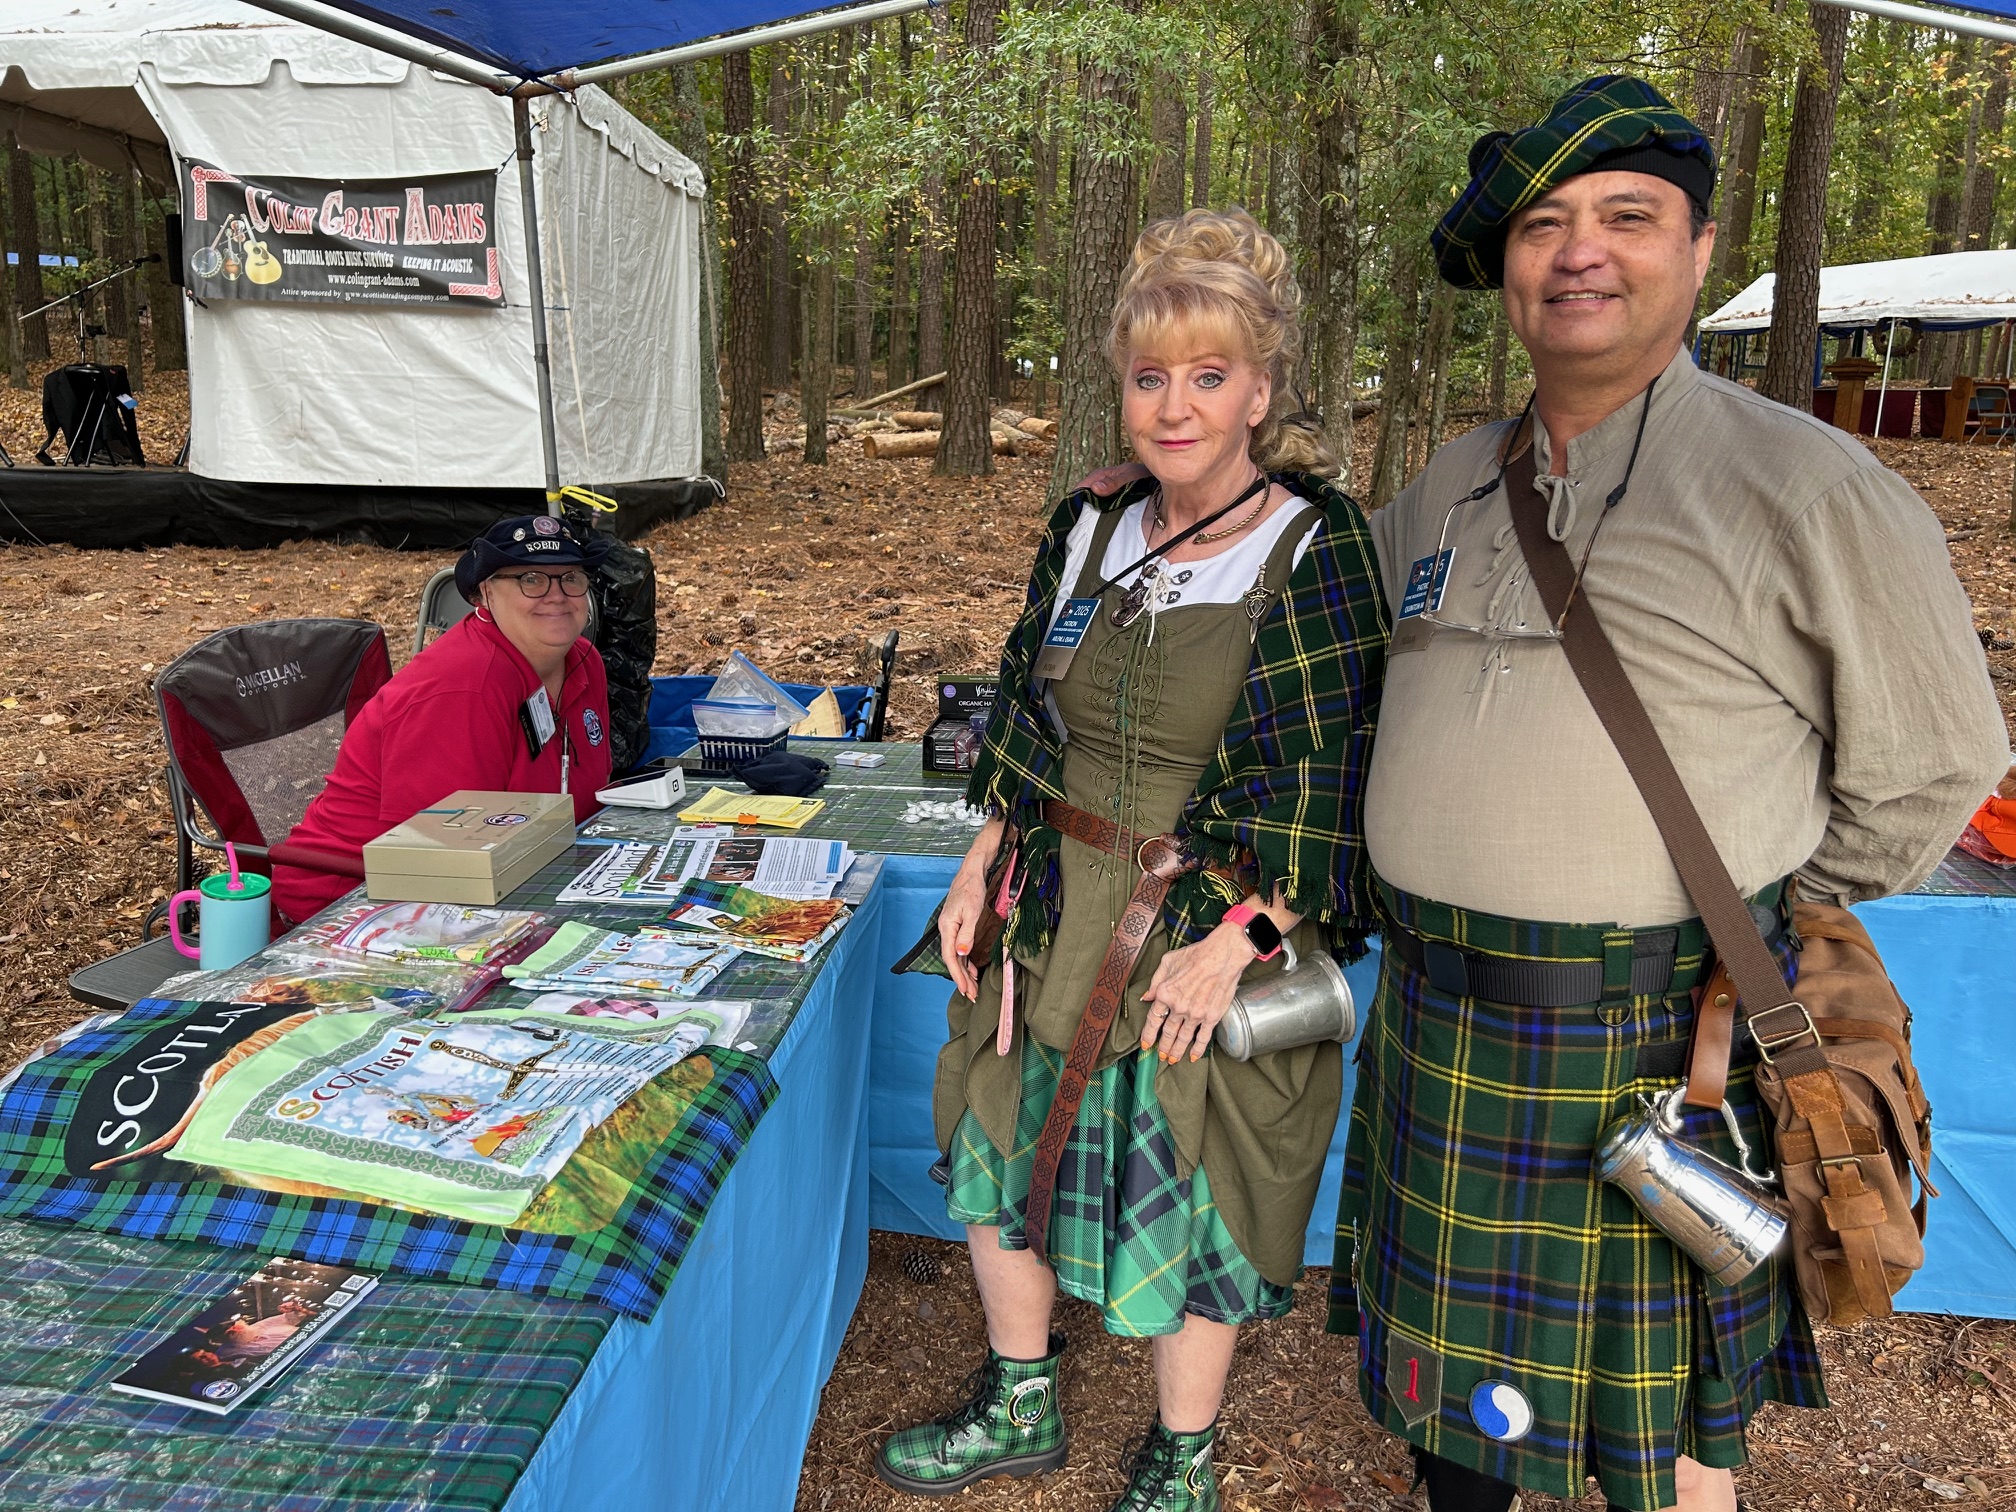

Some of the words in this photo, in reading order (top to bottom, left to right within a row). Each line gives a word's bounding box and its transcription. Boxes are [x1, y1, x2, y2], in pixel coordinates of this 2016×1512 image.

[245, 186, 318, 234] COLIN
[319, 189, 400, 245] GRANT
[403, 187, 487, 246] ADAMS
[283, 249, 325, 266] TRADITIONAL
[325, 250, 345, 267] ROOTS
[344, 250, 364, 267] MUSIC
[363, 250, 394, 268] SURVIVES
[402, 256, 432, 271] KEEPING
[432, 259, 441, 271] IT
[441, 258, 473, 274] ACOUSTIC
[327, 272, 420, 288] www.colingrant-adams.com
[281, 288, 299, 296] Attire
[300, 289, 333, 298] sponsored
[333, 290, 342, 298] by
[525, 541, 561, 552] ROBIN
[1426, 559, 1446, 576] 25
[1073, 605, 1091, 616] 2025
[245, 661, 302, 690] MAGELLAN
[278, 1036, 422, 1120] SCOTTISH
[242, 1367, 260, 1382] Join
[255, 1349, 284, 1371] Scottish
[280, 1331, 309, 1353] Heritage
[302, 1320, 320, 1332] USA
[315, 1307, 337, 1322] today
[1404, 1357, 1420, 1403] 1
